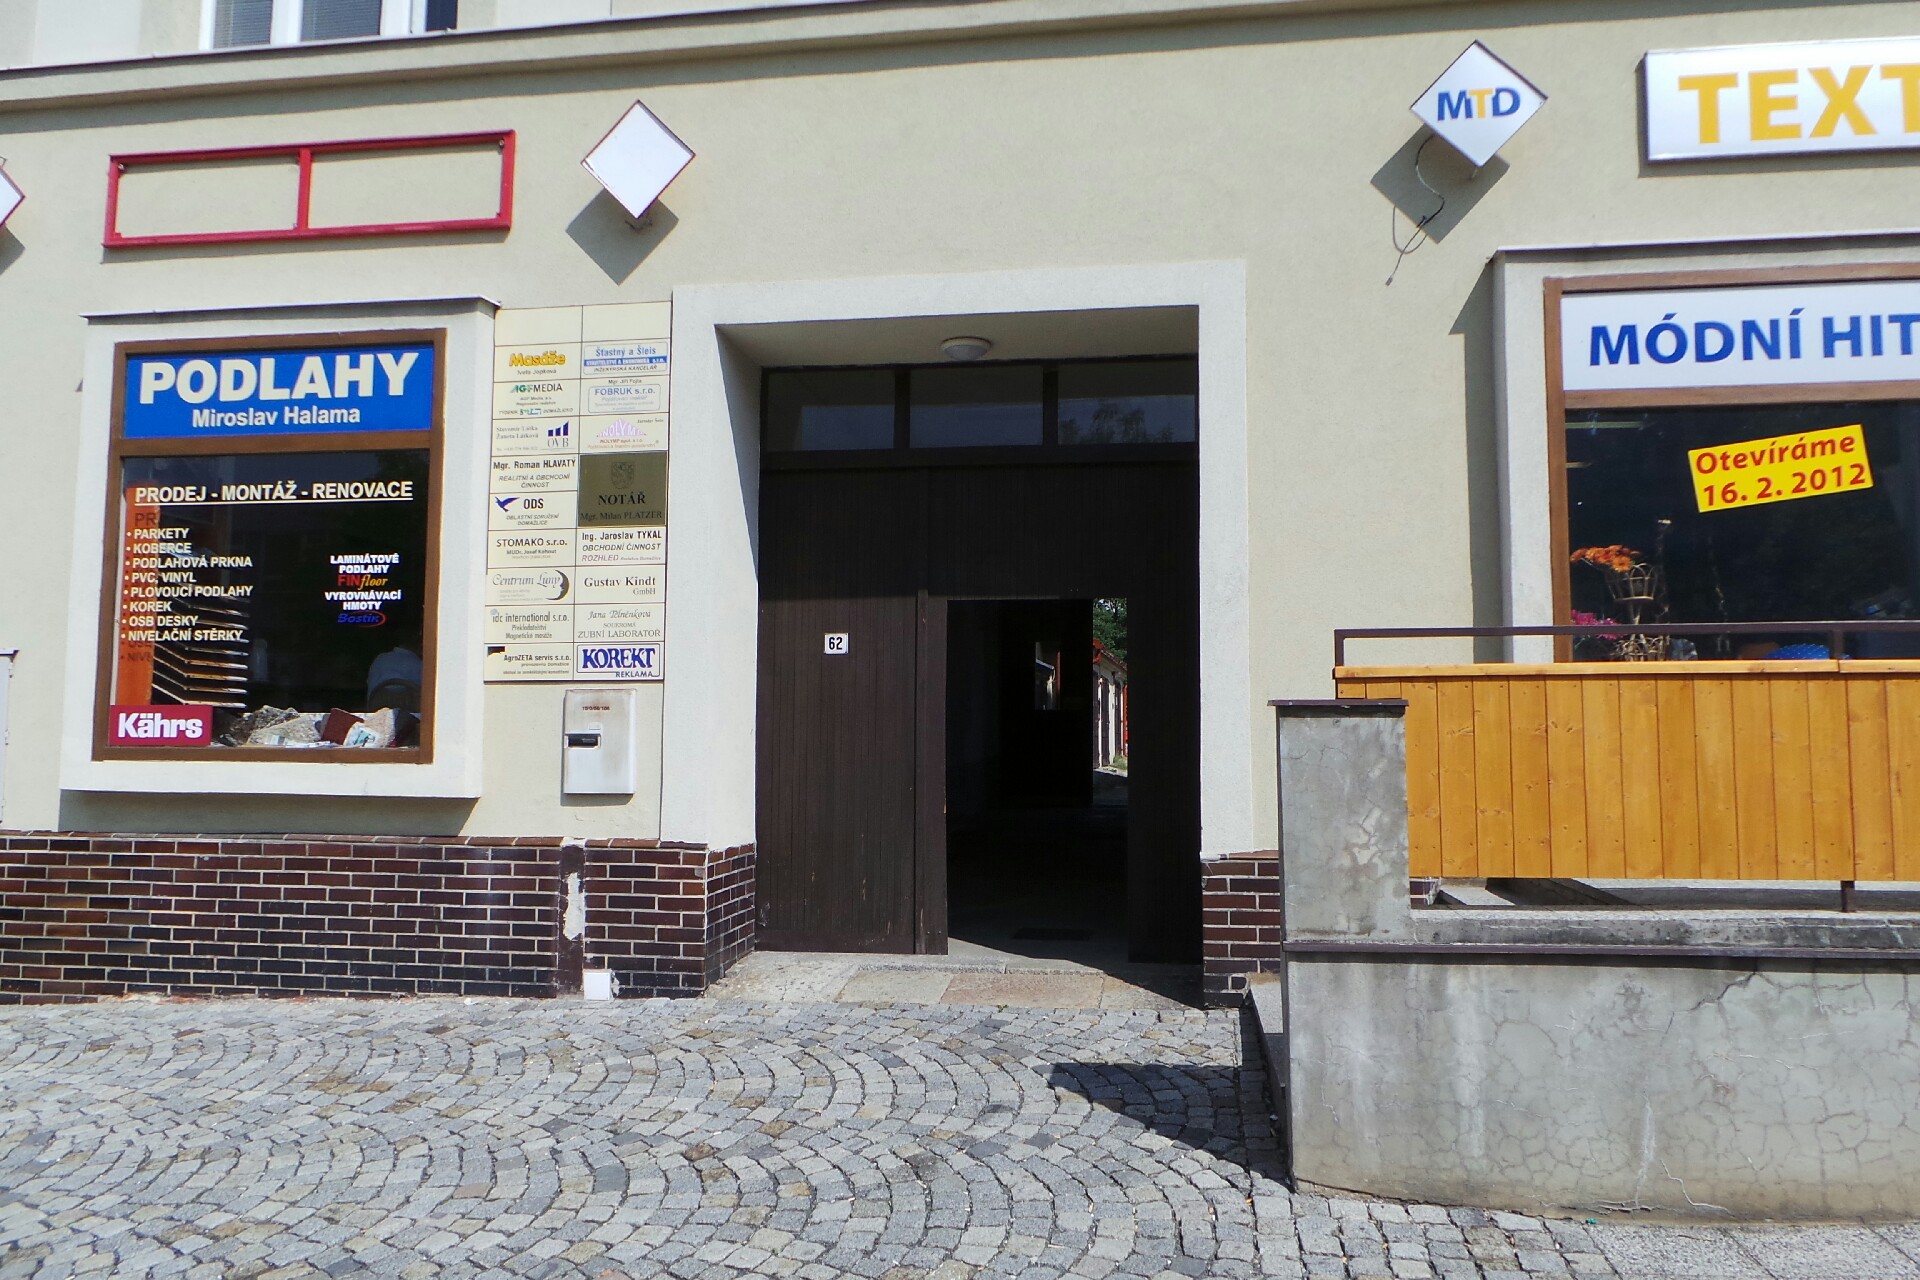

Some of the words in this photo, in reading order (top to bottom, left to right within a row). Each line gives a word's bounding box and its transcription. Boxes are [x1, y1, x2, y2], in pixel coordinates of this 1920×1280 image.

[1437, 87, 1521, 122] MTD
[1678, 63, 1920, 144] TEXT
[1589, 307, 1805, 367] MÓDNÍ
[1822, 312, 1920, 359] HIT
[140, 352, 419, 404] PODLAHY
[595, 387, 632, 396] FOBRUK
[192, 407, 278, 429] Miroslav
[283, 405, 361, 426] Halama
[547, 438, 569, 447] OVB
[1695, 436, 1857, 475] Otevíráme
[493, 461, 511, 471] Mgr.
[514, 460, 541, 469] Roman
[543, 457, 577, 468] HLAVATÝ
[135, 486, 207, 503] PRODEJ
[221, 481, 297, 502] MONTÁŽ
[312, 481, 413, 499] RENOVACE
[598, 490, 646, 506] NOTÁŘ
[523, 498, 544, 509] ODS
[133, 527, 190, 541] PARKETY
[582, 532, 597, 542] Ing.
[600, 531, 634, 540] Jaroslav
[637, 530, 663, 539] TYKAL
[133, 543, 193, 554] KOBERCE
[496, 537, 544, 547] STOMAKO
[582, 543, 625, 551] OBCHODNÍ
[626, 543, 662, 551] ČINNOST
[132, 554, 208, 569] PODLAHOVÁ
[210, 556, 253, 568] PRKNA
[330, 553, 400, 564] LAMINÁTOVÉ
[581, 554, 619, 562] ROZHLED
[338, 565, 390, 574] PODLAHY
[162, 571, 197, 583] VINYL
[492, 573, 534, 586] Centrum
[584, 577, 621, 587] Gustav
[130, 585, 192, 599] PLOVOUCÍ
[196, 585, 254, 598] PODLAHY
[324, 589, 402, 601] VYROVNÁVACÍ
[129, 600, 174, 613] KOREK
[342, 601, 384, 611] HMOTY
[129, 615, 154, 628] OSB
[157, 615, 199, 628] DESKY
[505, 610, 550, 623] international
[128, 628, 192, 642] NIVELAČNÍ
[194, 628, 244, 642] STĚRKY
[578, 629, 605, 639] ZUBNÍ
[828, 636, 843, 651] 62
[534, 653, 553, 661] servis
[582, 647, 656, 669] KOREKT
[117, 712, 204, 739] Kährs
